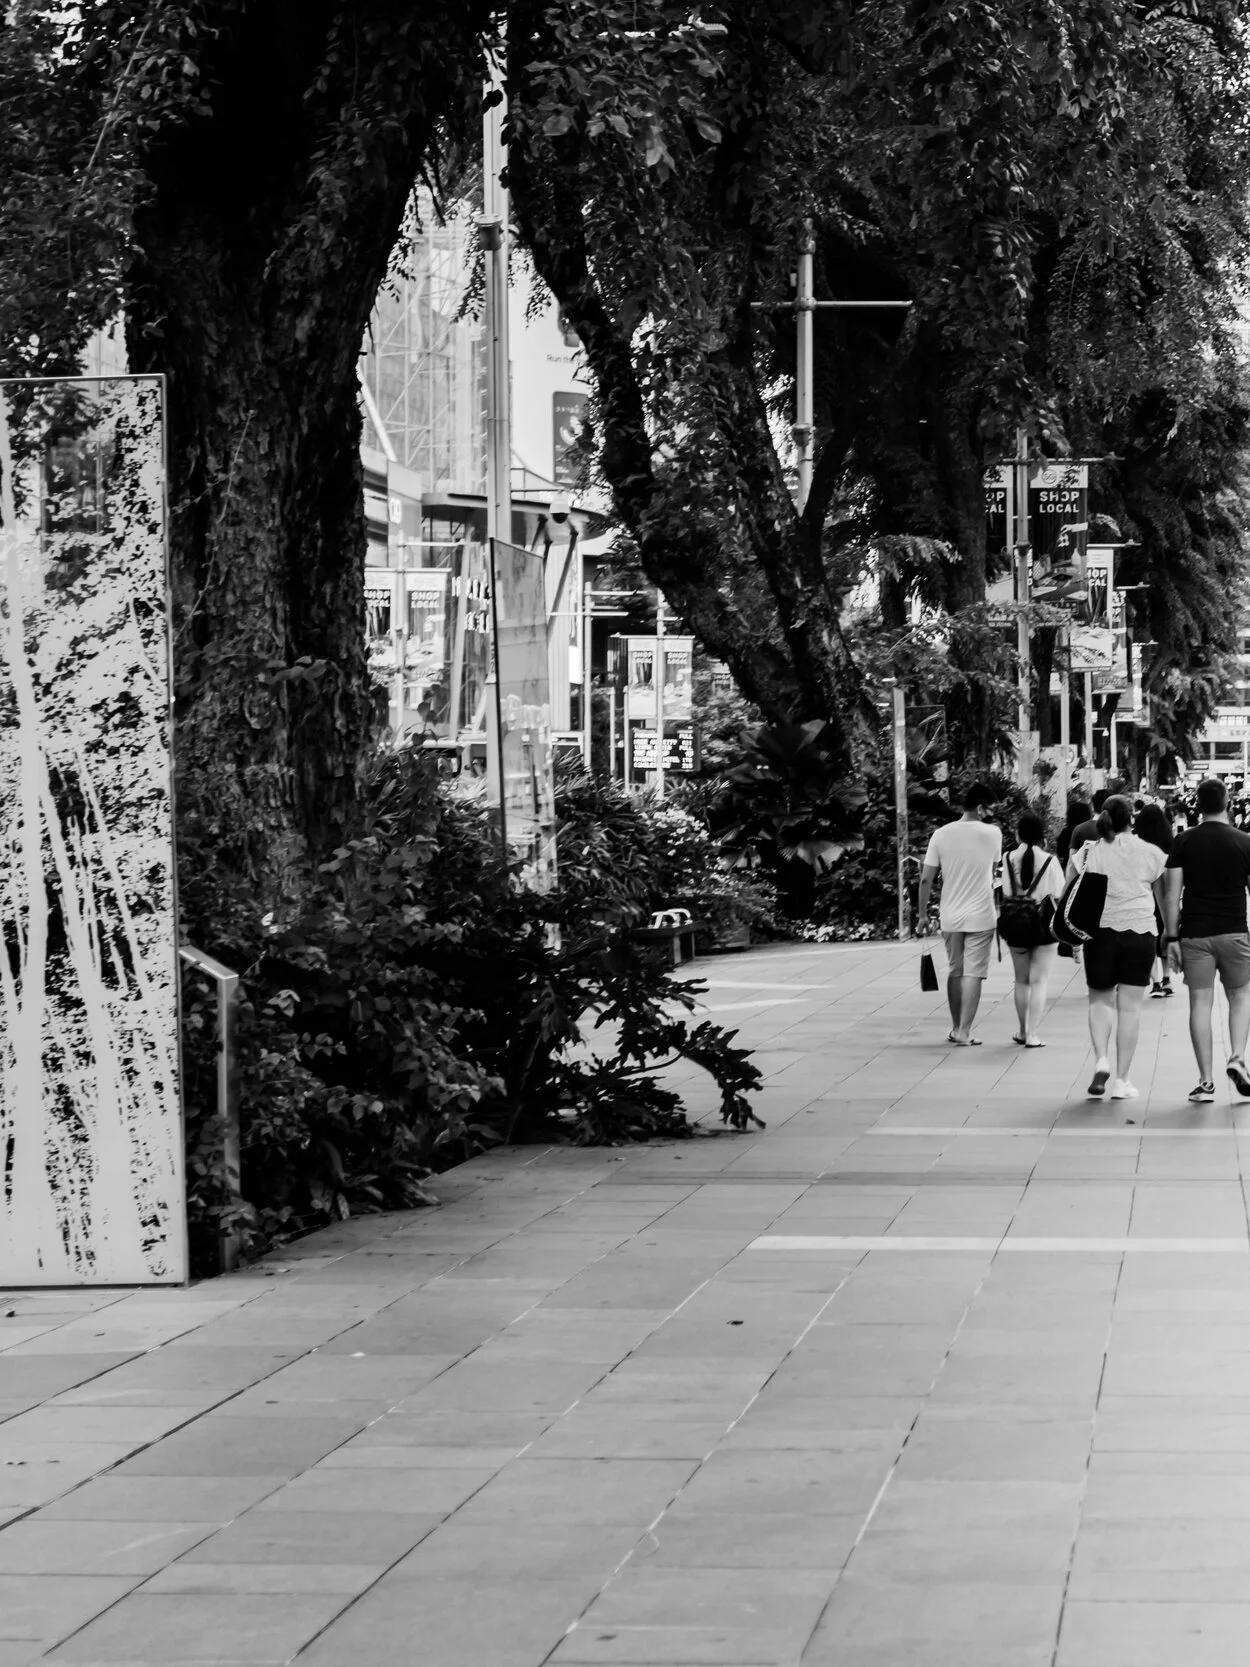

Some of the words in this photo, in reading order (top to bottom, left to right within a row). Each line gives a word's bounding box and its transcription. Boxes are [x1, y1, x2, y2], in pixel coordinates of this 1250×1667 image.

[1039, 491, 1080, 502] SHOP
[1039, 504, 1080, 513] LOCAL
[411, 591, 440, 601] SHOP
[411, 601, 440, 609] LOCAL
